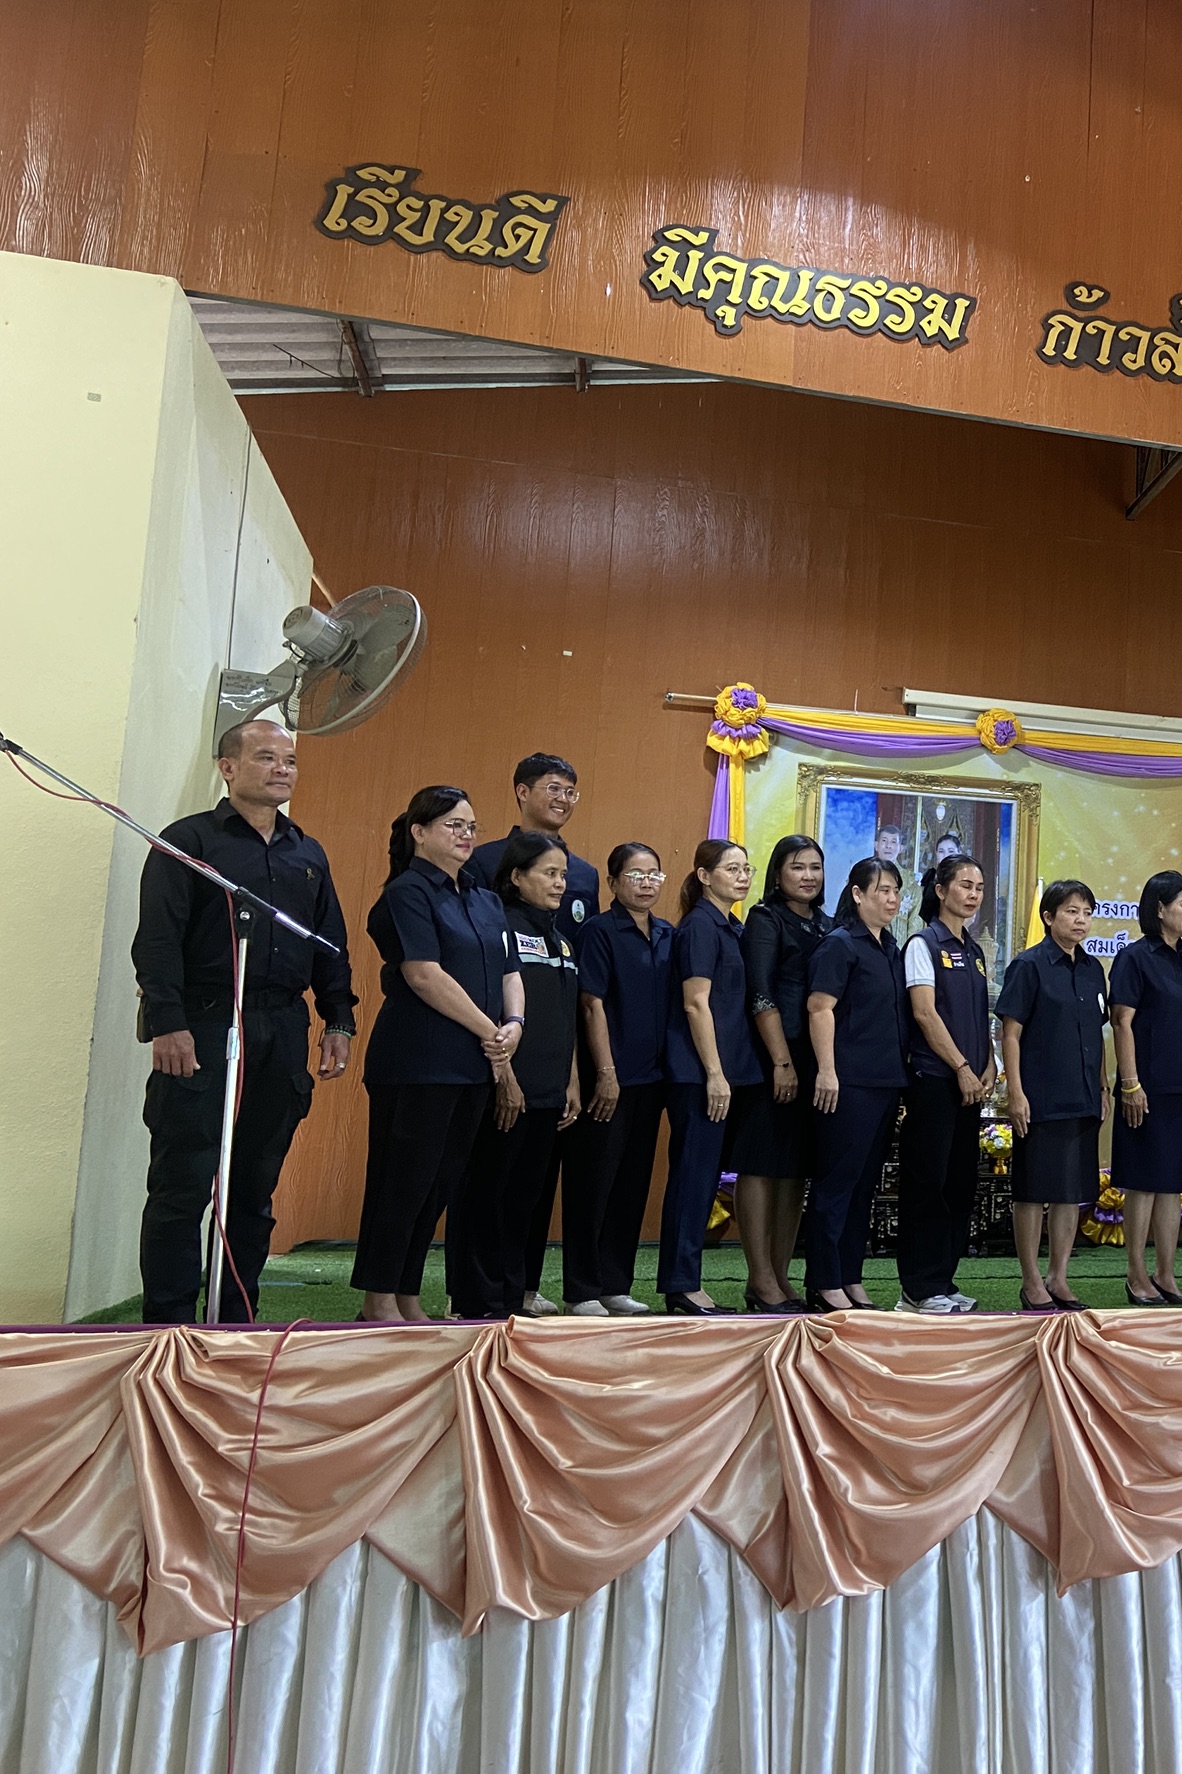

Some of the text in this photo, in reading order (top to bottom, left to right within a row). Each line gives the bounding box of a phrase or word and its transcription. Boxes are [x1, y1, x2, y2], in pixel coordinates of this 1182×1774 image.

[323, 167, 555, 264] เรียนดี
[650, 226, 970, 341] มีคุณธรรม
